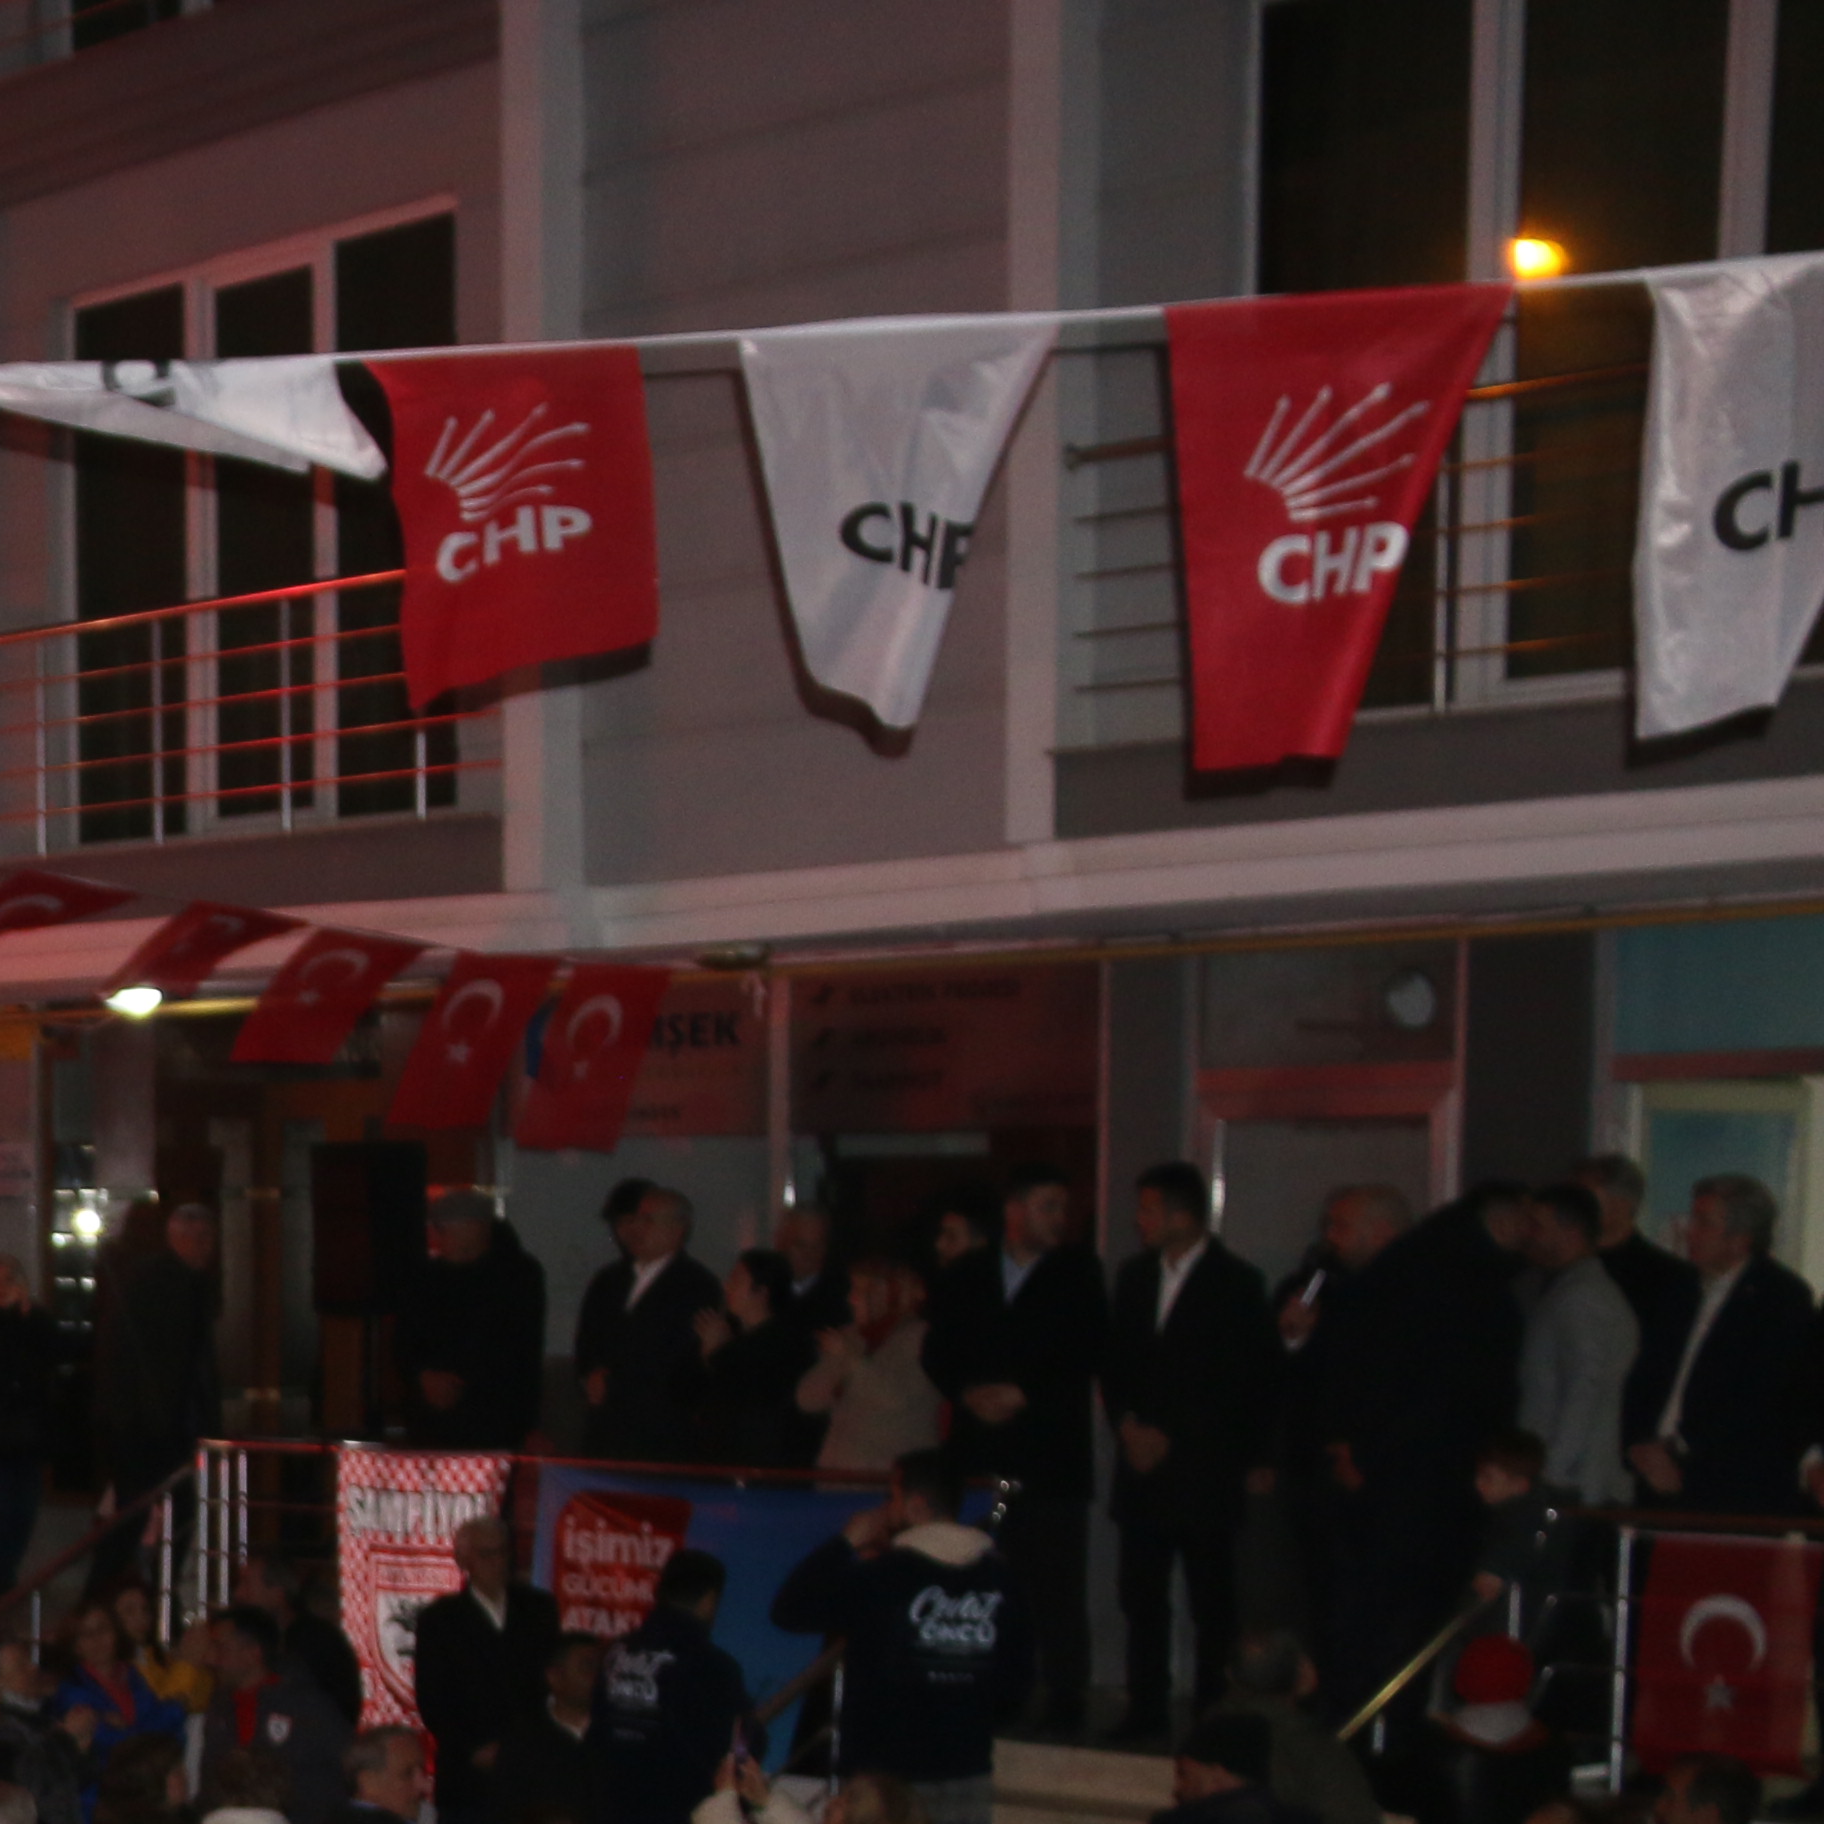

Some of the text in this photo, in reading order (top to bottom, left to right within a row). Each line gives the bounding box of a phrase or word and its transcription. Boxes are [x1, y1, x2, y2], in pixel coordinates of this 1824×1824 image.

[436, 504, 594, 586] CHP
[839, 500, 975, 590] CHP
[1712, 458, 1824, 551] CH
[1256, 521, 1409, 606] CHP
[562, 1567, 662, 1604] GÜCÜM
